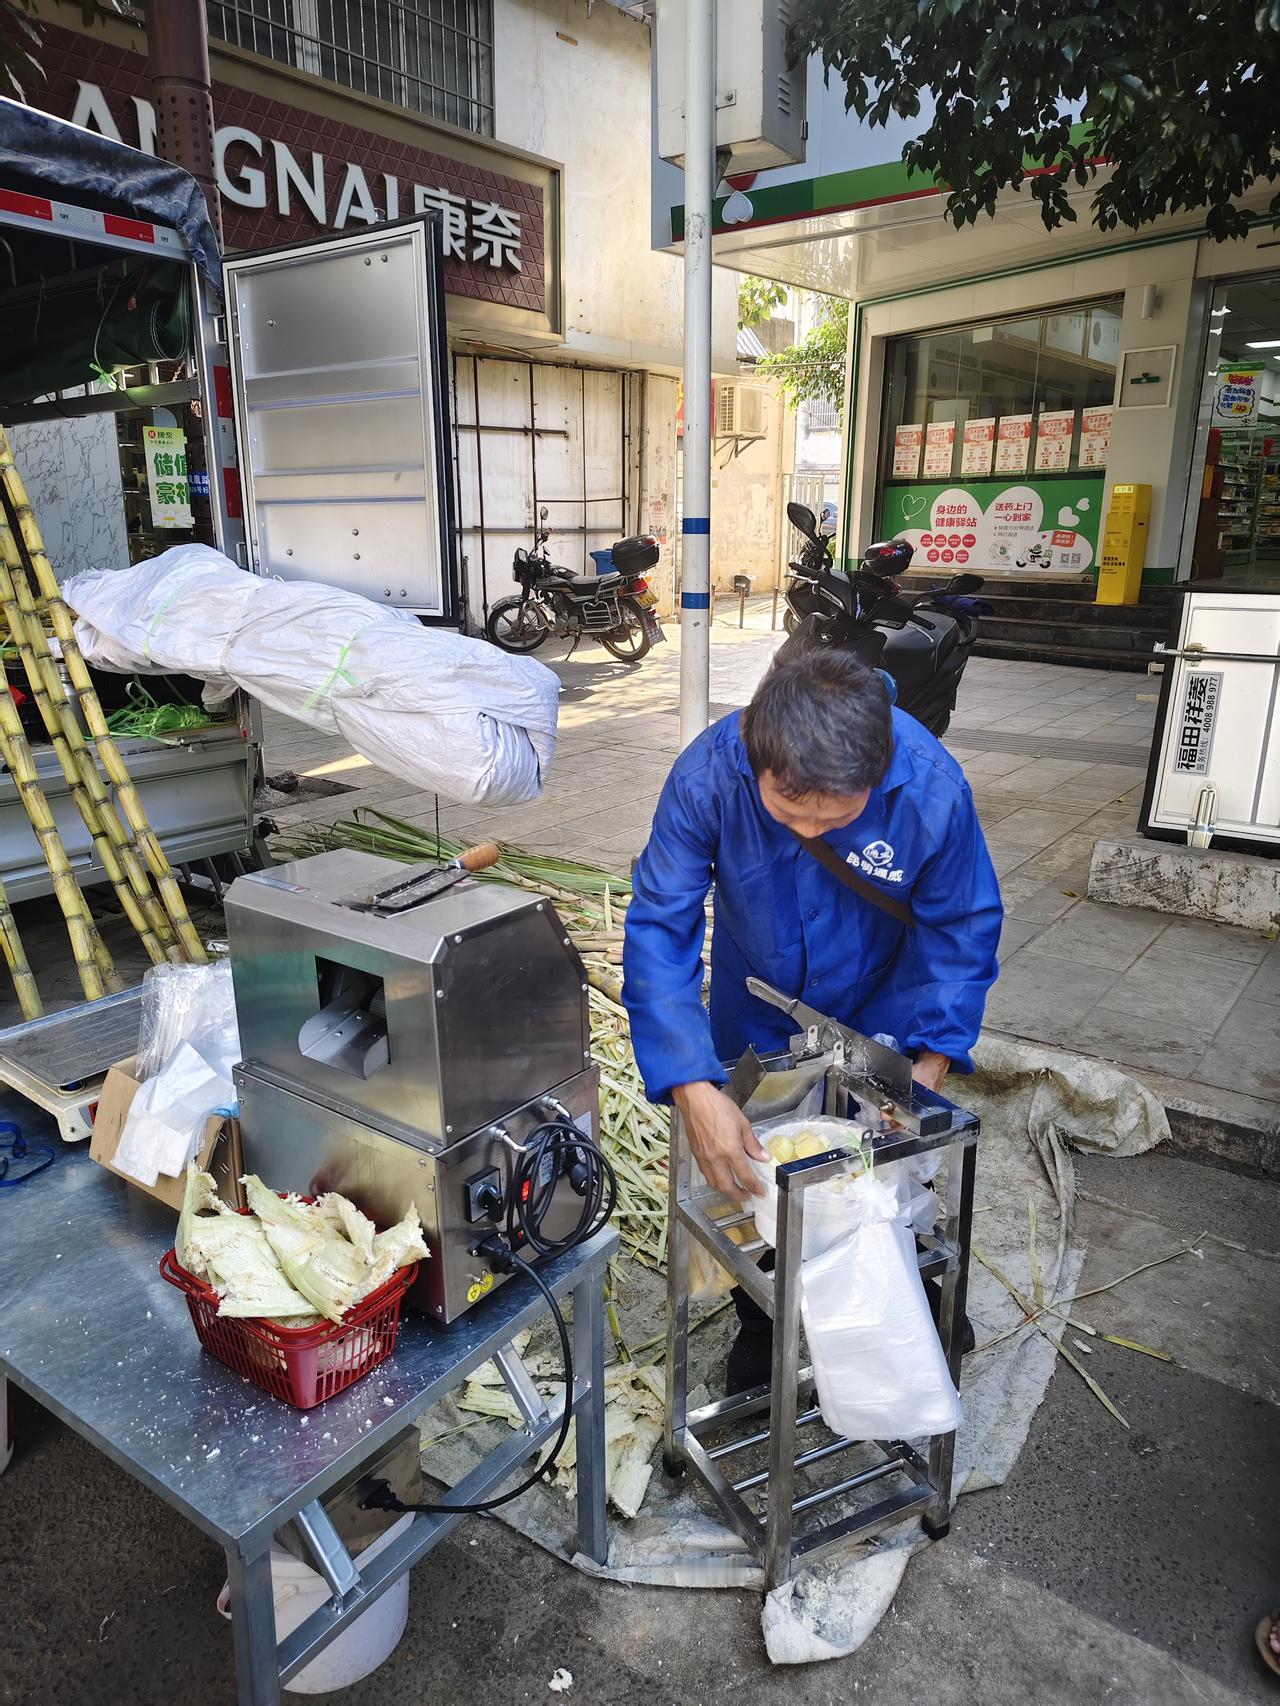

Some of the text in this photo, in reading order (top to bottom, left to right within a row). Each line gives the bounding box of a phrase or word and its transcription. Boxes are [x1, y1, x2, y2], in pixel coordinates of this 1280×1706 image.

[414, 184, 522, 273] 康奈
[936, 504, 967, 515] 身边的
[995, 502, 1033, 511] 送药上门
[935, 517, 977, 527] 健康驿站
[994, 513, 1032, 522] 一心到家
[1209, 677, 1218, 693] 977
[1206, 695, 1216, 710] 988
[1178, 676, 1208, 770] 福田祥菱
[1203, 712, 1213, 733] 4008
